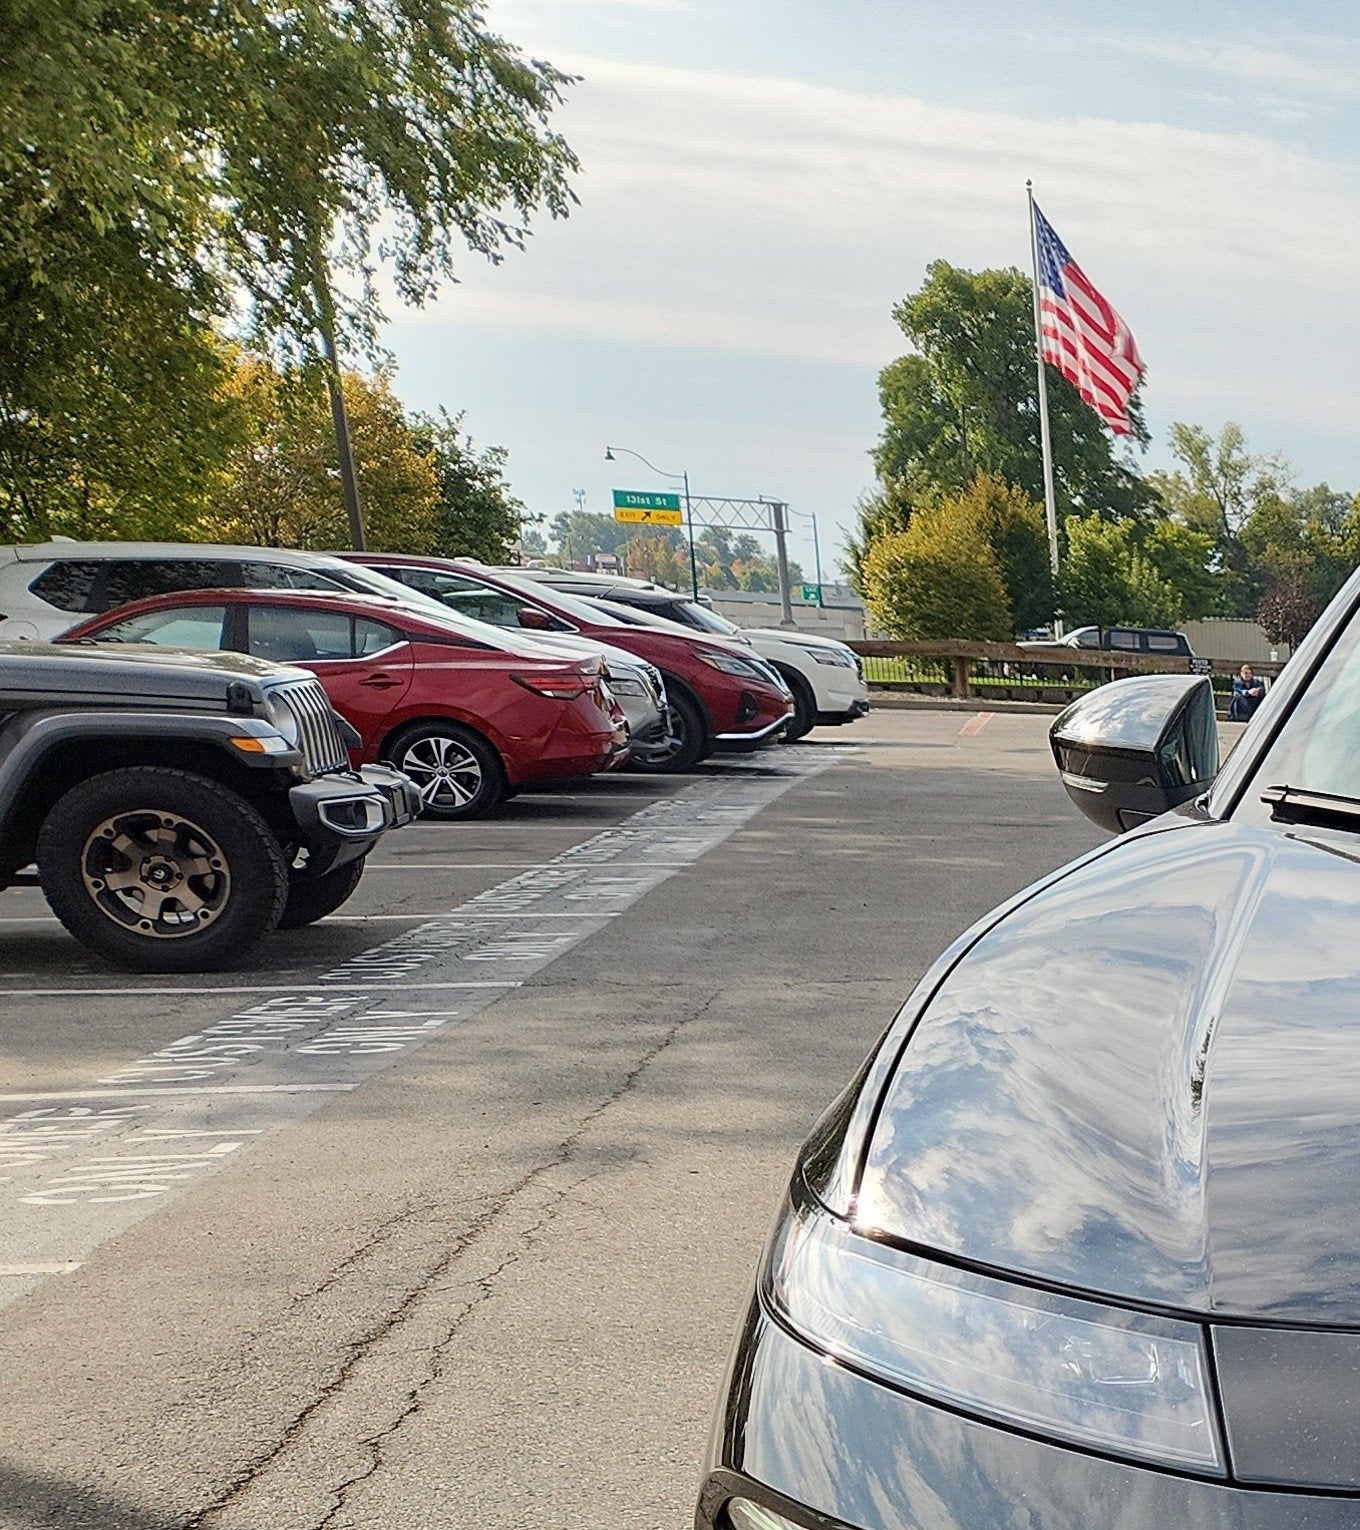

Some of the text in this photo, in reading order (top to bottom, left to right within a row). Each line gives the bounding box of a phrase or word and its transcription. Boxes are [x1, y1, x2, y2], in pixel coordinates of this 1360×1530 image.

[655, 497, 667, 506] St
[656, 513, 677, 521] ONLY
[462, 932, 579, 961] ONLY
[97, 997, 369, 1084] CUSTOMER
[297, 1010, 459, 1055] ONLY
[18, 1129, 264, 1204] ONLY
